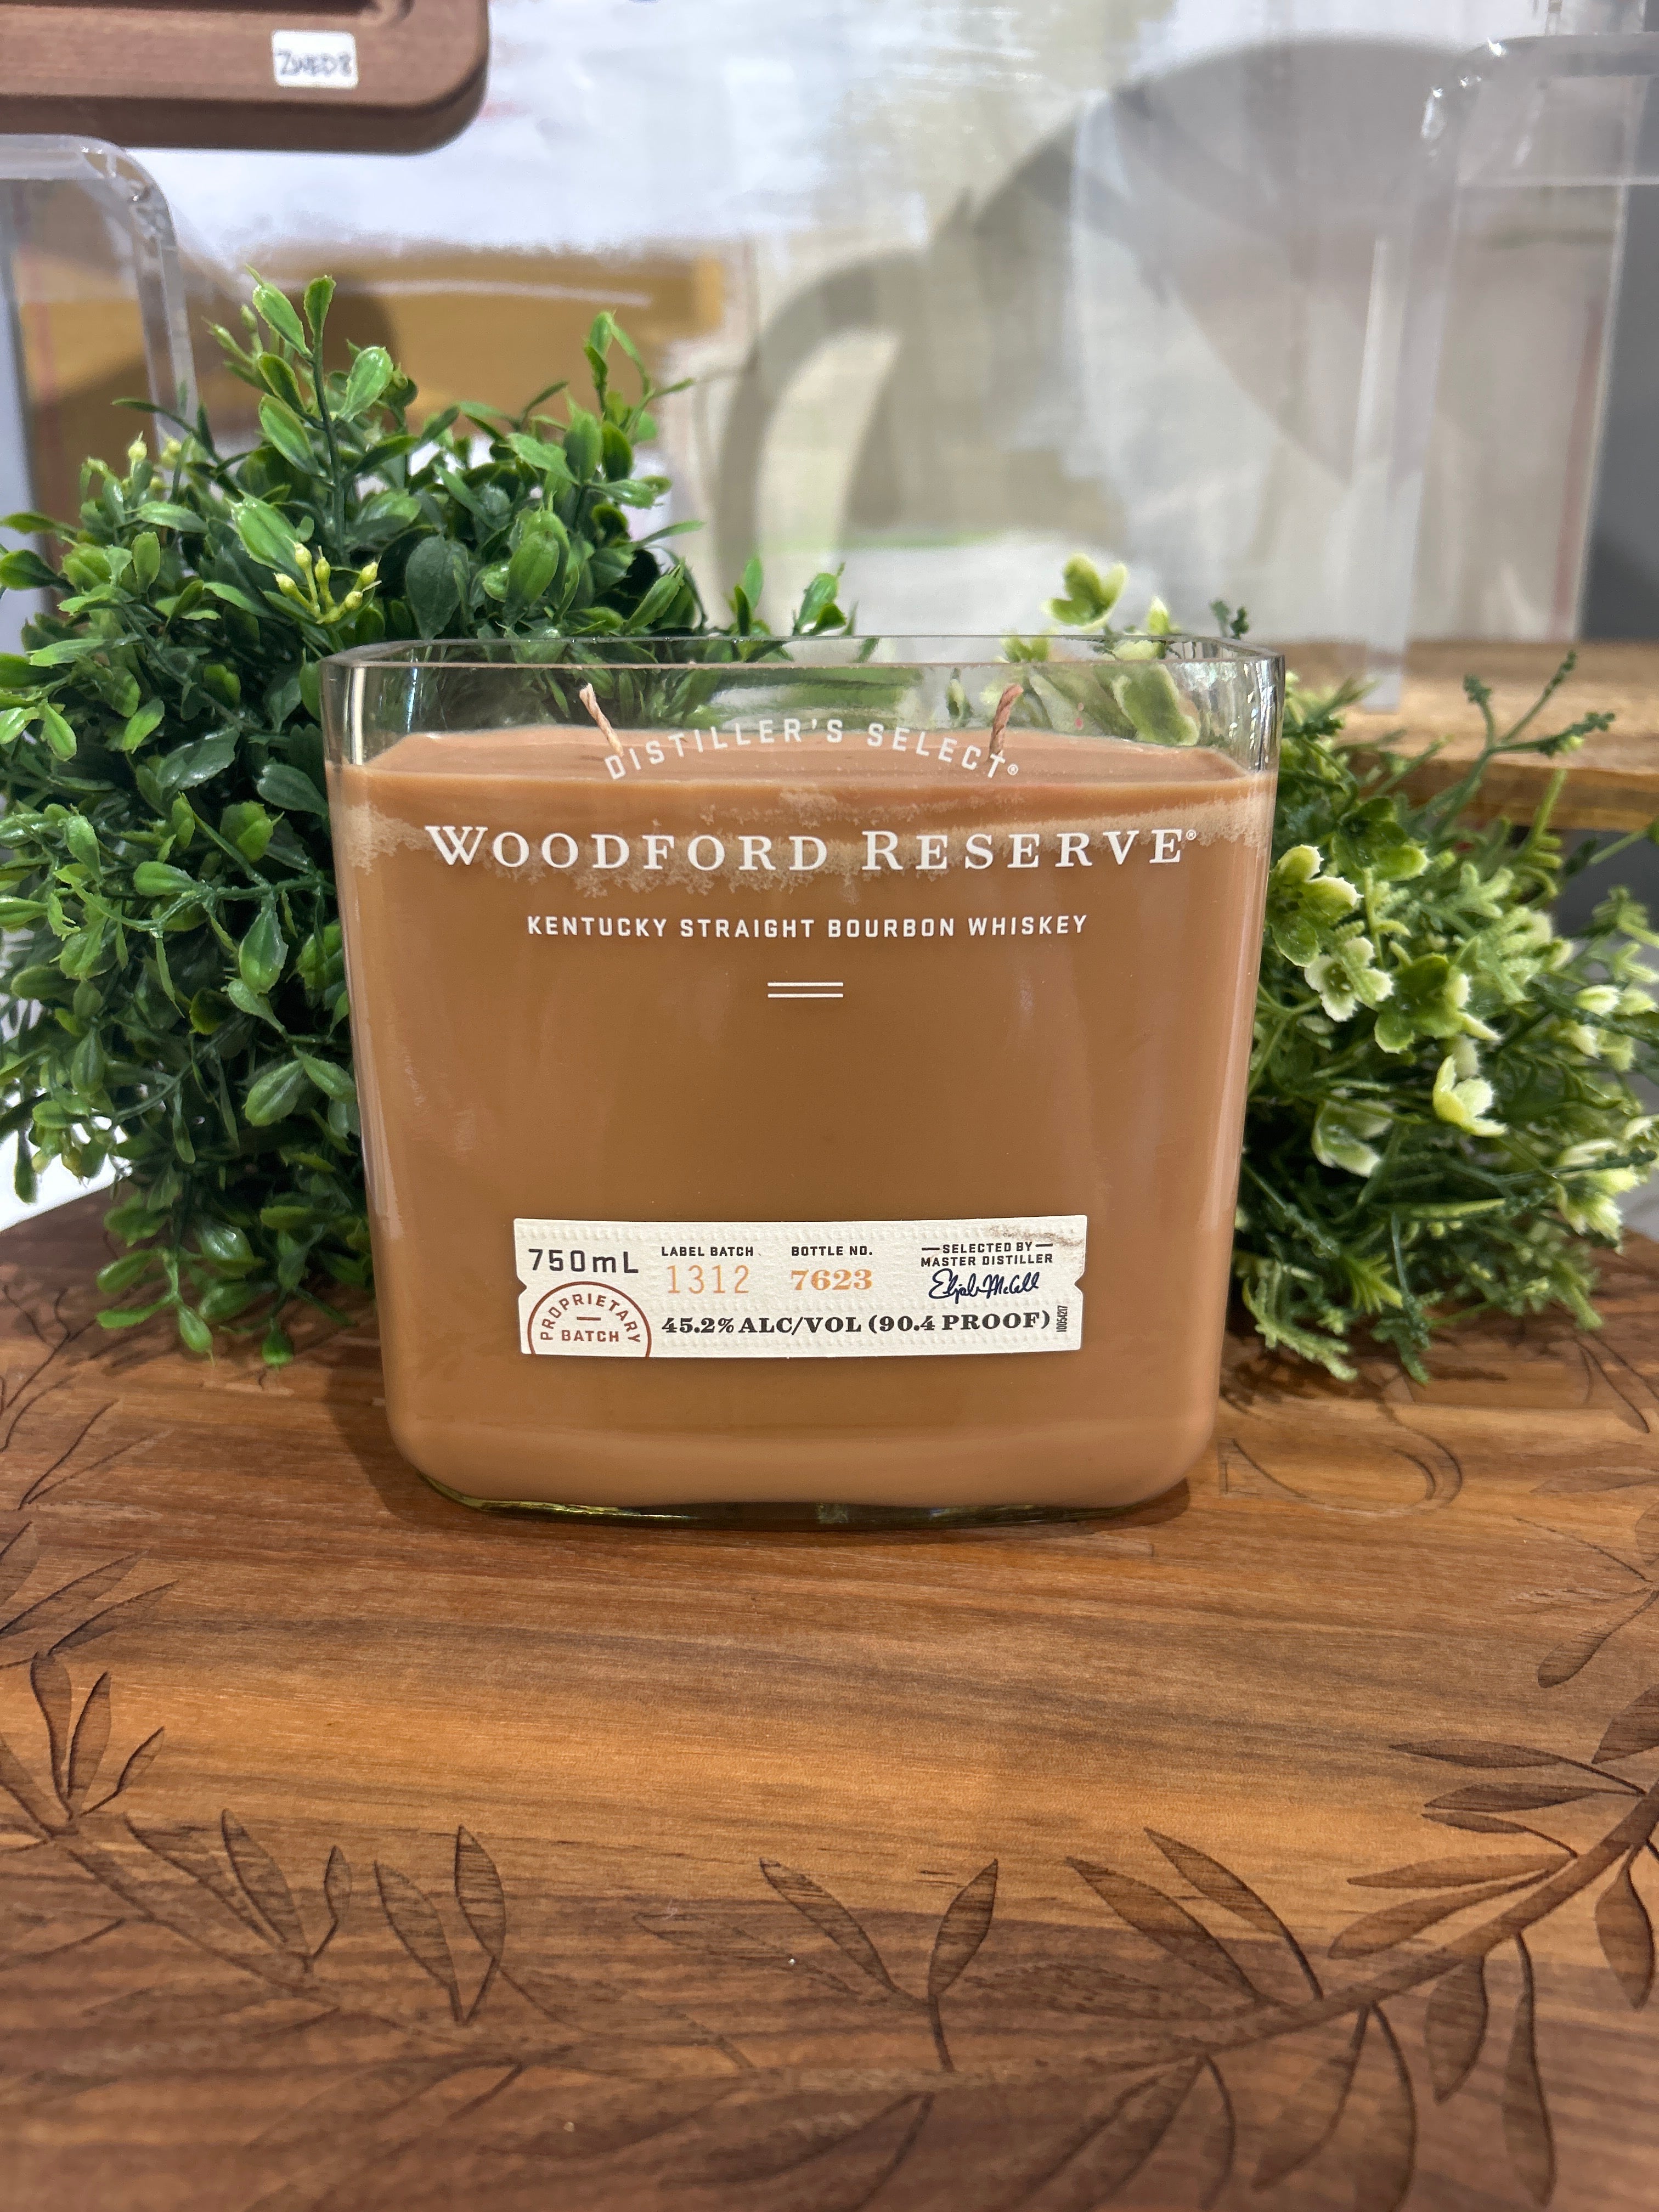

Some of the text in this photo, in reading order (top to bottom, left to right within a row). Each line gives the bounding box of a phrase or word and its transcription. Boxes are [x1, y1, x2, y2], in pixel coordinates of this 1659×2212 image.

[604, 719, 843, 780] DISTILLER'S
[425, 826, 827, 871] WOODFORD
[528, 915, 1087, 938] KENTUCKY STRAIGHT BOURBON WHISKEY
[661, 1246, 754, 1256] LABEL BATCH
[792, 1245, 873, 1256] BOTTLE NO.
[943, 1242, 1033, 1254] SELECTED BY
[528, 1248, 639, 1273] 750mL
[921, 1254, 1053, 1268] MASTER DISTILLER
[667, 1265, 749, 1294] 1312
[791, 1268, 873, 1291] 7623
[540, 1293, 641, 1344] PROPRIETARY
[661, 1310, 1050, 1335] 45.2% ALC/VOL (90.4 PROOF)
[1056, 1305, 1068, 1333] 10054217
[562, 1329, 620, 1343] BATCH
